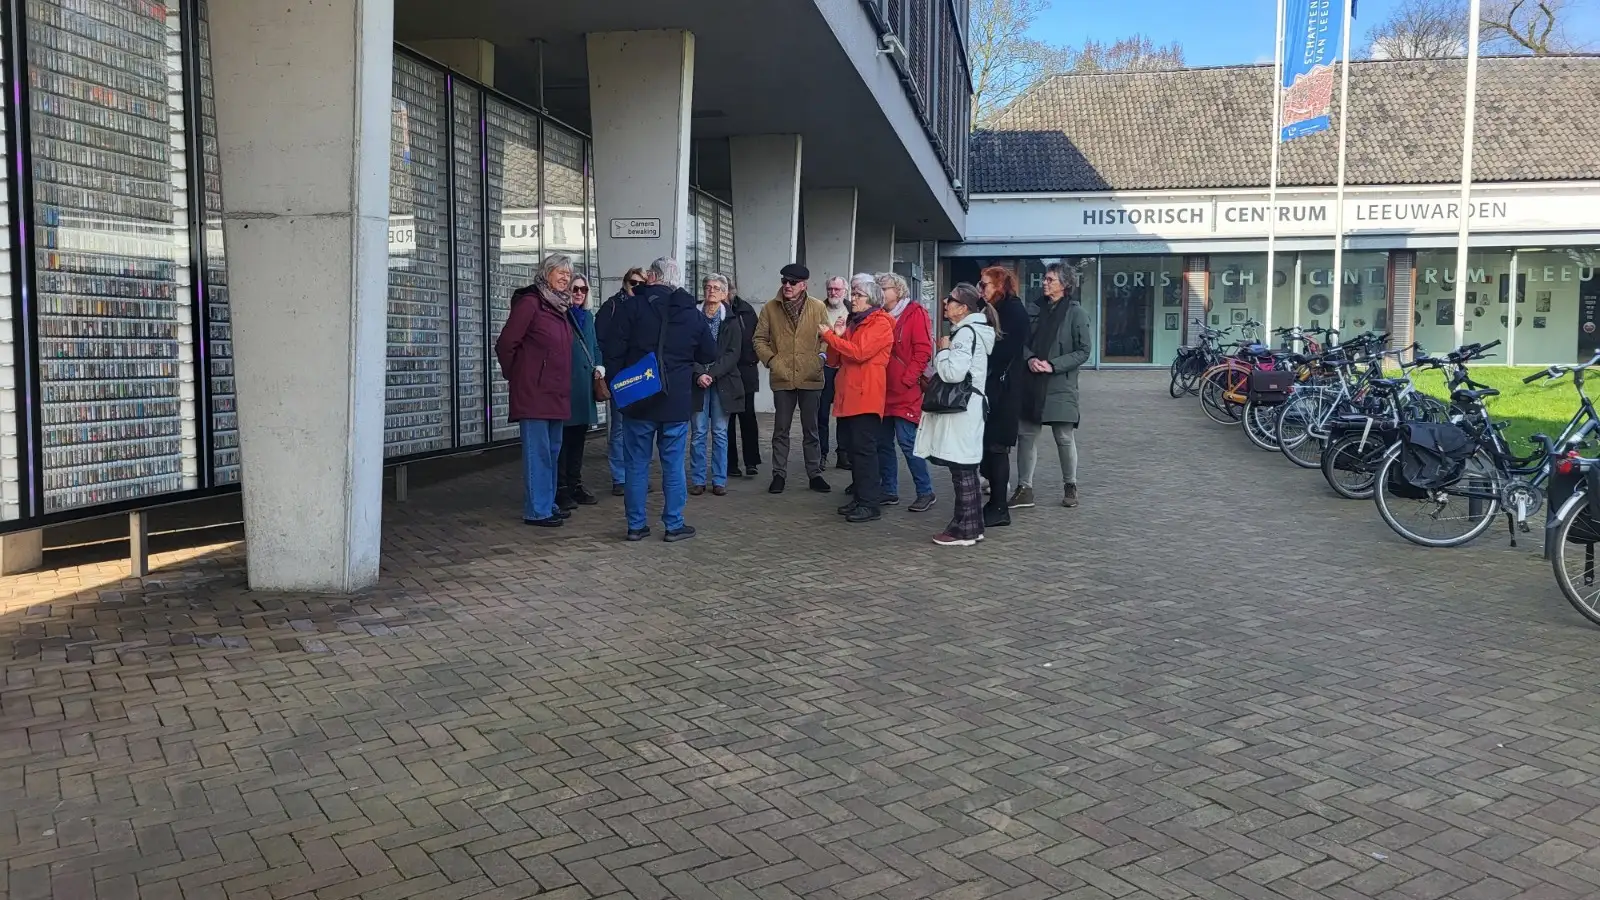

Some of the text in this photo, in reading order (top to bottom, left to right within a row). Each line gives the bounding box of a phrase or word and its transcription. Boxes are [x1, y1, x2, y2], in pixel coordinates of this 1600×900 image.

[1304, 0, 1318, 65] SCHATTEN
[1315, 1, 1330, 63] VAN LEEU
[627, 228, 657, 236] bewaking
[1083, 208, 1204, 225] HISTORISCH
[1356, 202, 1506, 220] LEEUWARDEN
